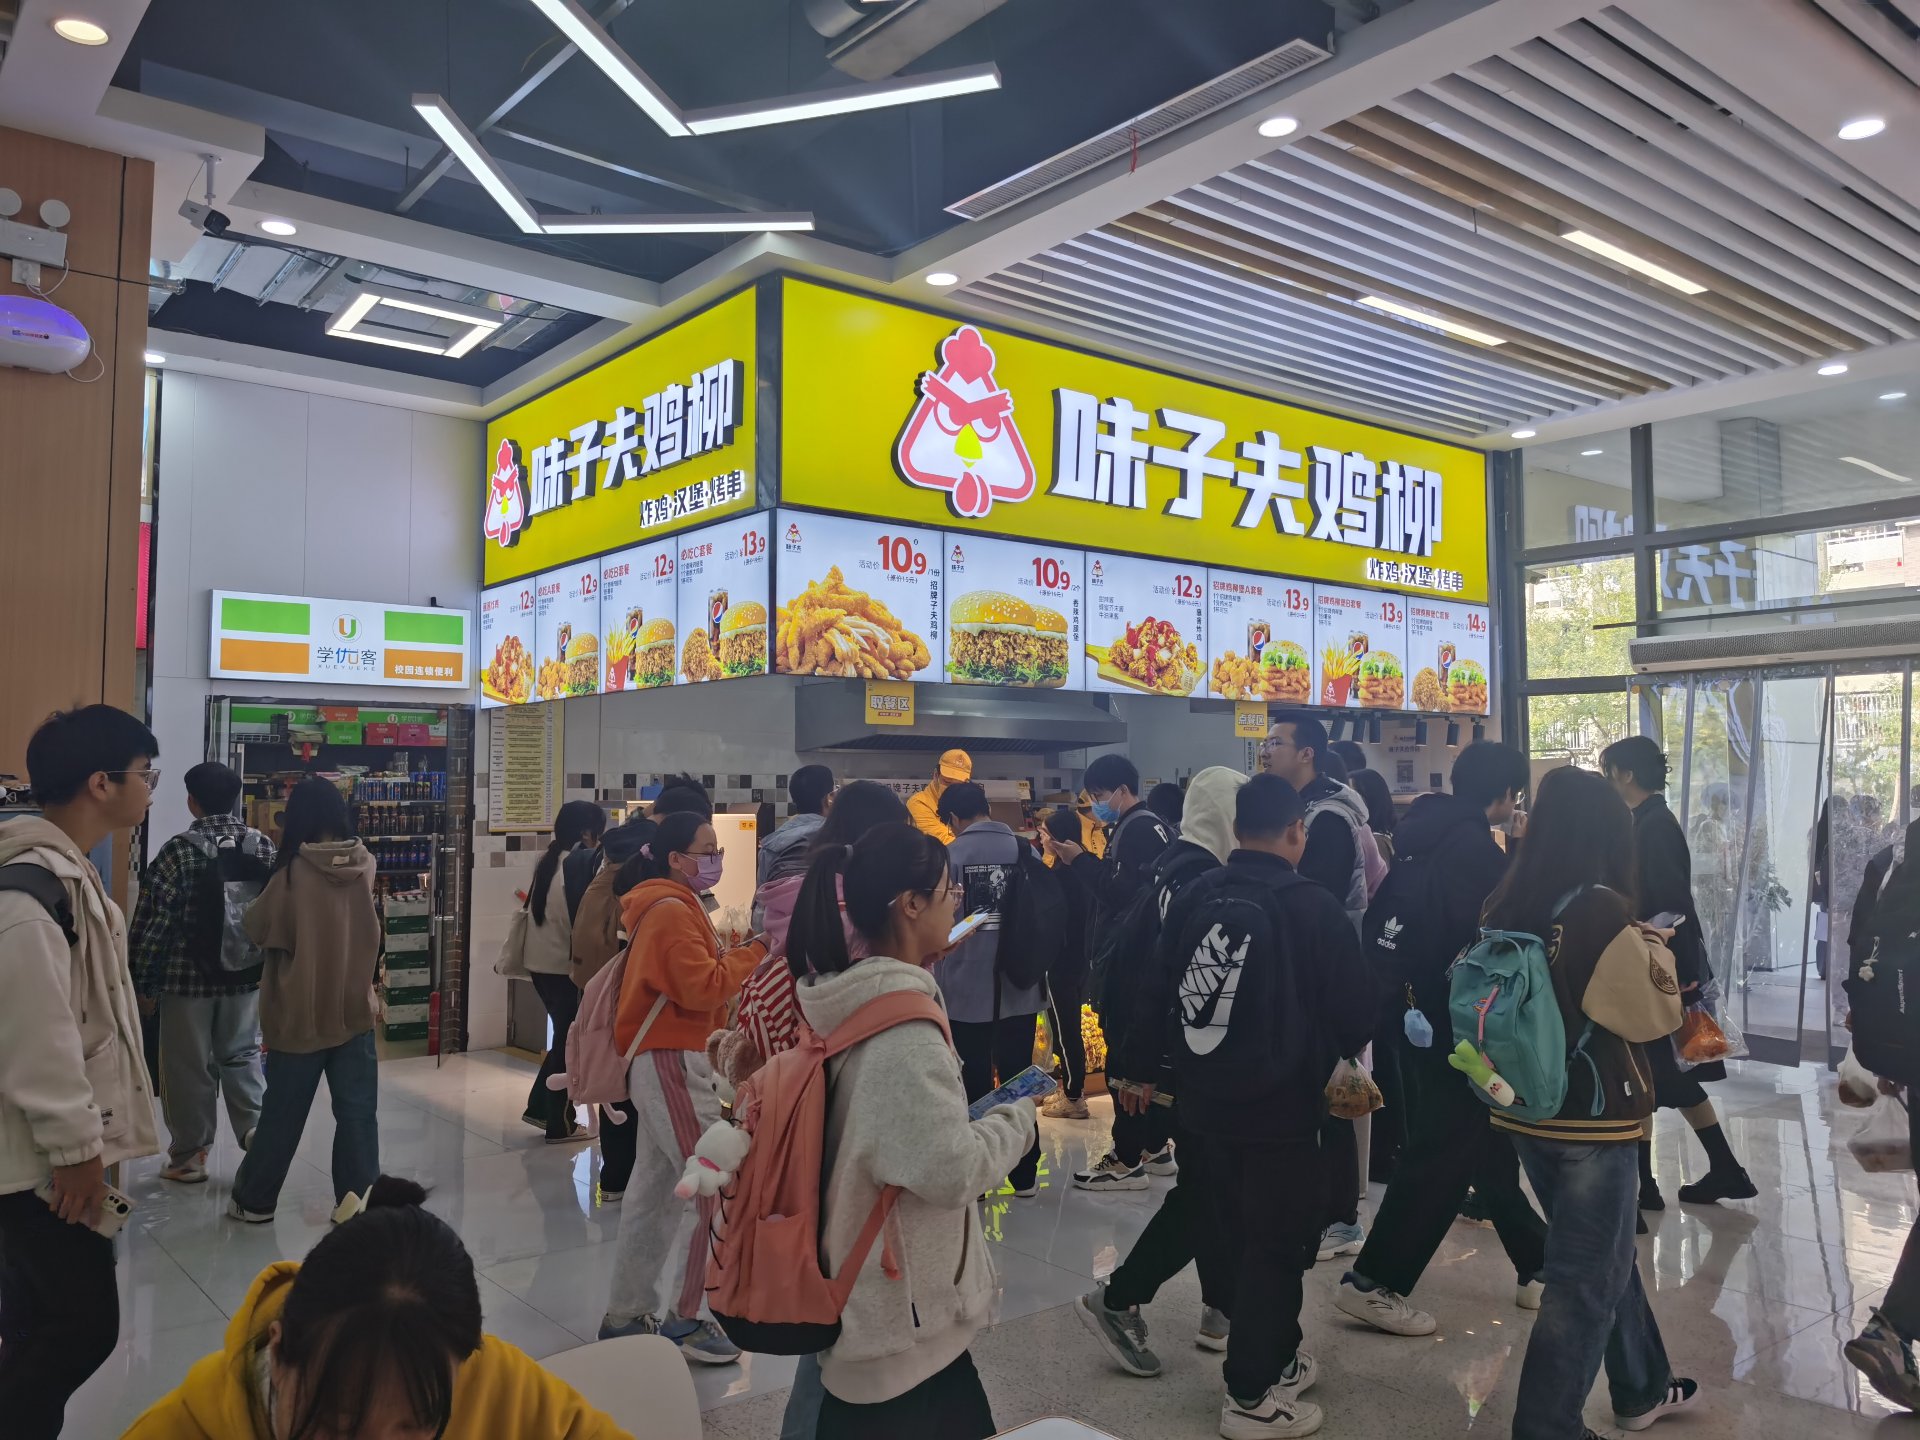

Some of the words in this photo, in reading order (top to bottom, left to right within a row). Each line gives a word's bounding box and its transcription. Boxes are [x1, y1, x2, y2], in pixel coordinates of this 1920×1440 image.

[529, 359, 739, 516] 味子夫鸡柳
[1050, 387, 1443, 556] 味子夫鸡柳
[929, 580, 938, 640] 招牌子夫鸡柳
[394, 664, 453, 677] 校园连锁便利
[870, 695, 910, 711] 取餐区
